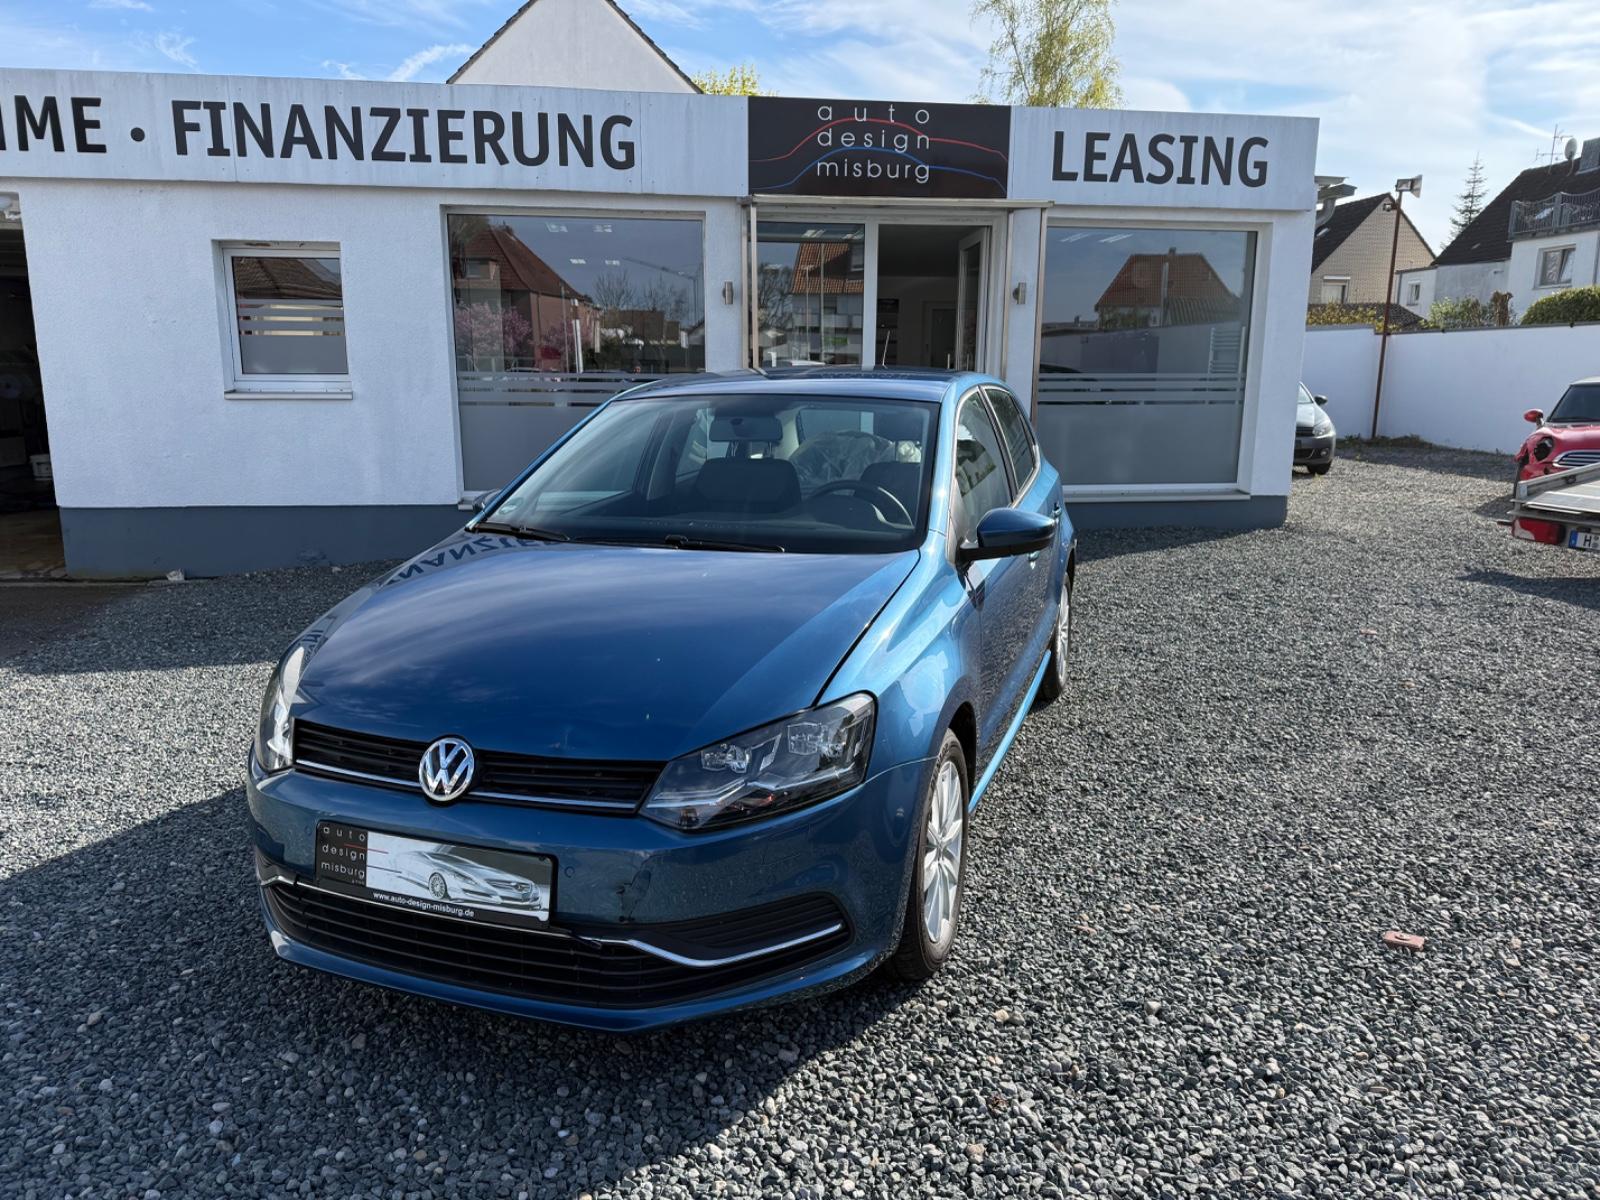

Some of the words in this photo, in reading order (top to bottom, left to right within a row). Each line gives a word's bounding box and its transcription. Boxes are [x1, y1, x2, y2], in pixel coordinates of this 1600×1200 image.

[817, 104, 930, 124] auto
[0, 95, 107, 154] ME
[171, 100, 636, 170] FINANZIERUNG
[817, 128, 930, 153] design
[817, 158, 930, 184] misburg
[1052, 131, 1269, 188] LEASING
[323, 826, 366, 842] auto
[322, 844, 365, 861] design
[321, 862, 365, 879] misburg
[373, 892, 476, 918] www.auto-design-misburg.de
